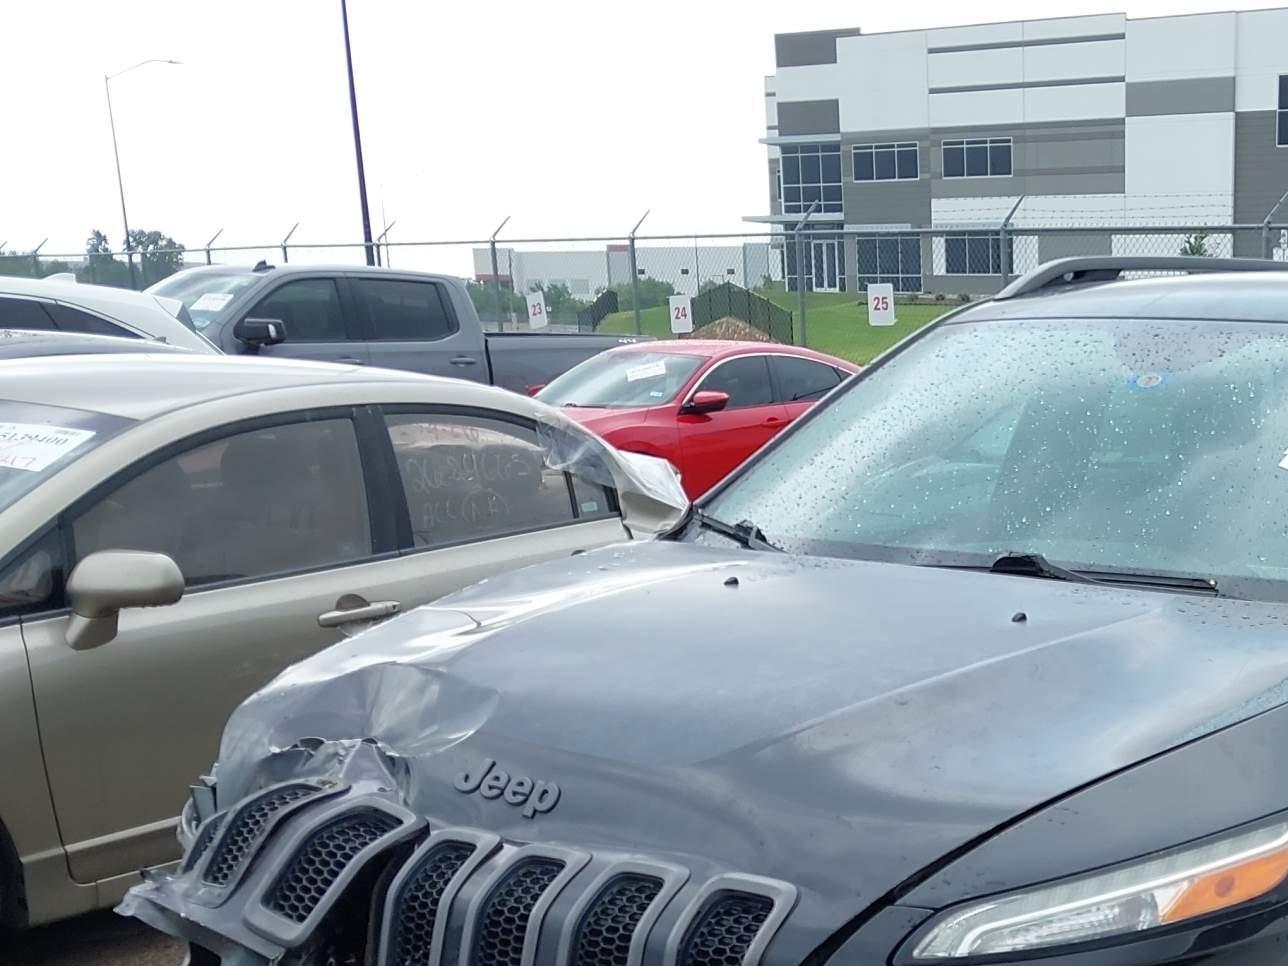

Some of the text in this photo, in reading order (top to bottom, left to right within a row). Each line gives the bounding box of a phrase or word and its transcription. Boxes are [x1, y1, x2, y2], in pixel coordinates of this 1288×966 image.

[531, 302, 543, 316] 23
[872, 296, 889, 311] 25
[674, 306, 688, 320] 24
[454, 759, 562, 819] Jeep
